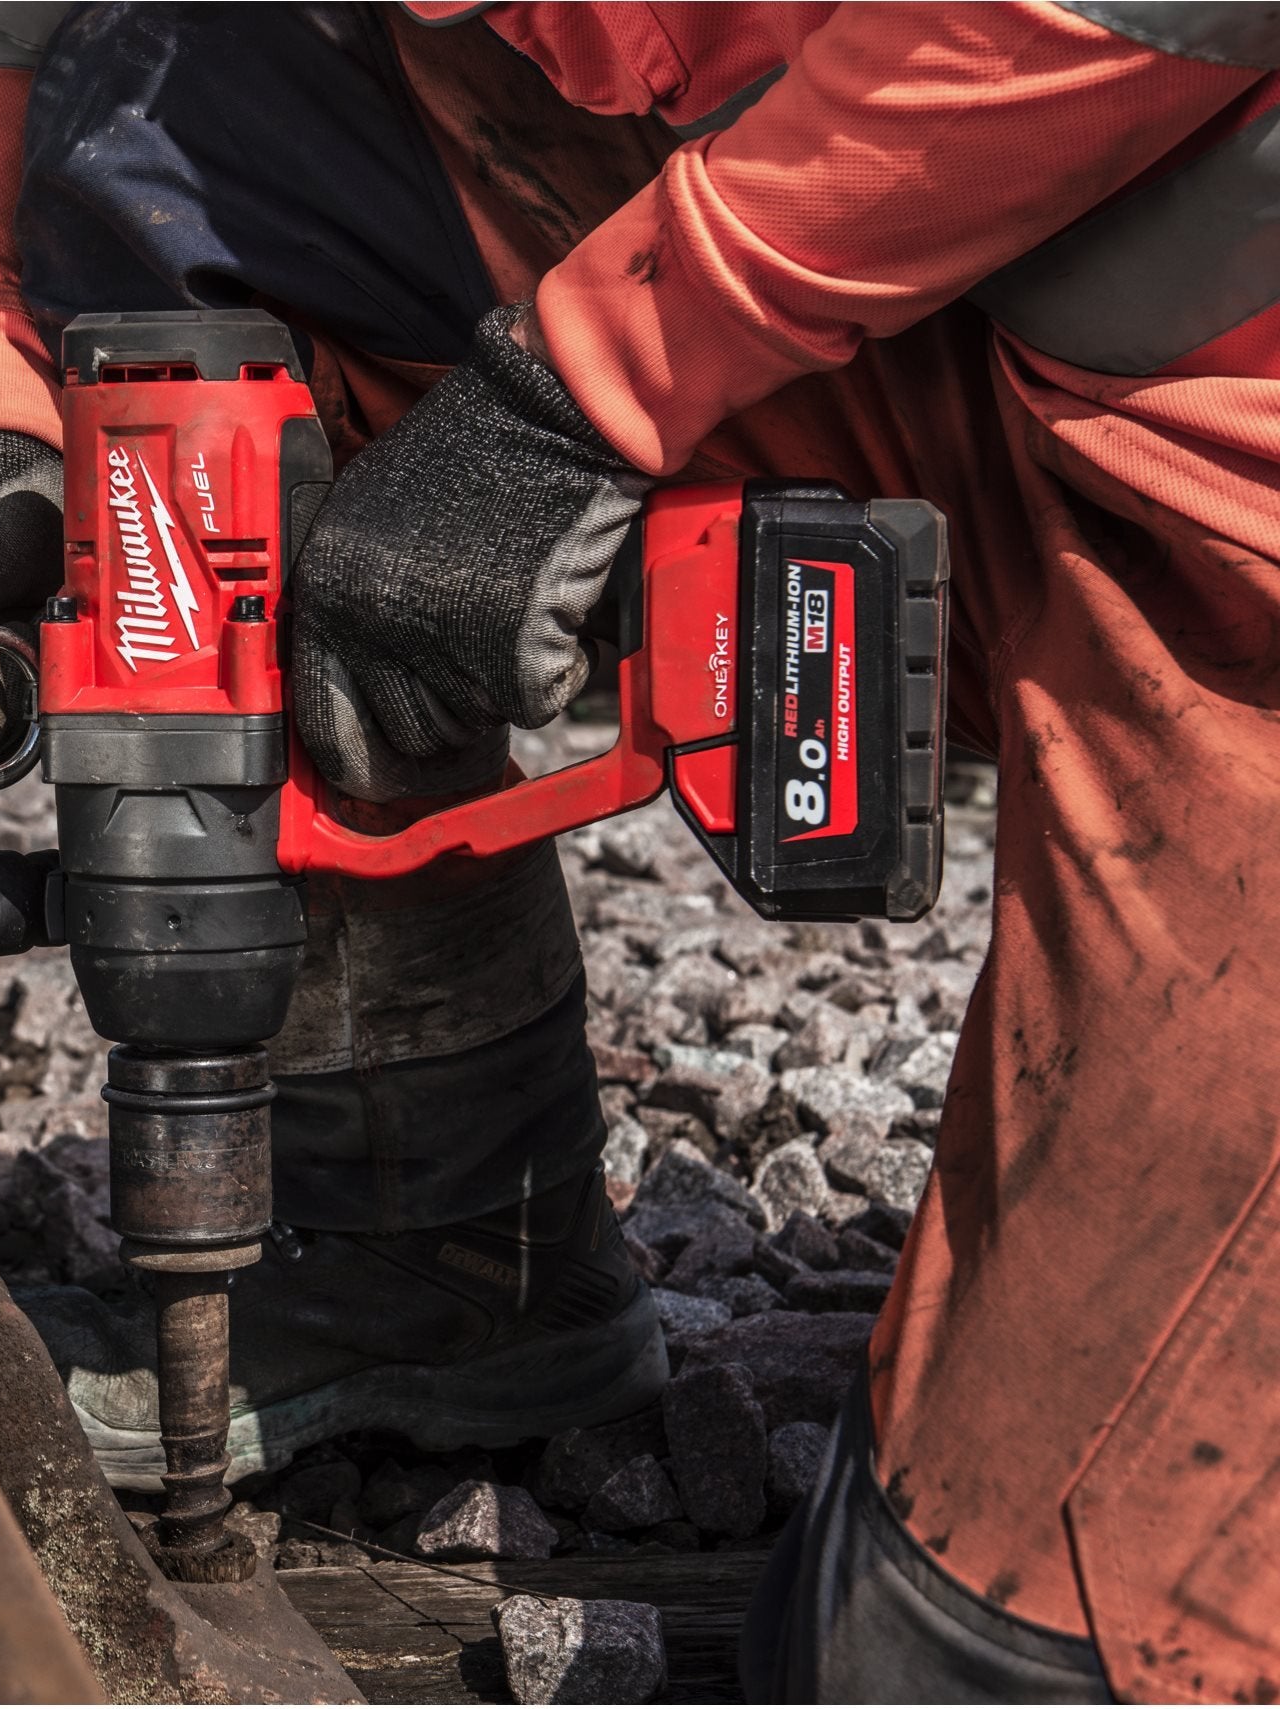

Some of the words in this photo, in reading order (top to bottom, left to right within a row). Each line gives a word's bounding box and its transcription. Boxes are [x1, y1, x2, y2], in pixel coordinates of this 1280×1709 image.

[191, 452, 221, 533] FUEL
[108, 446, 180, 672] Milwaukee
[806, 592, 827, 651] M18
[838, 643, 852, 714] OUTPUT
[837, 715, 850, 761] HIGH
[784, 738, 827, 825] 8.0
